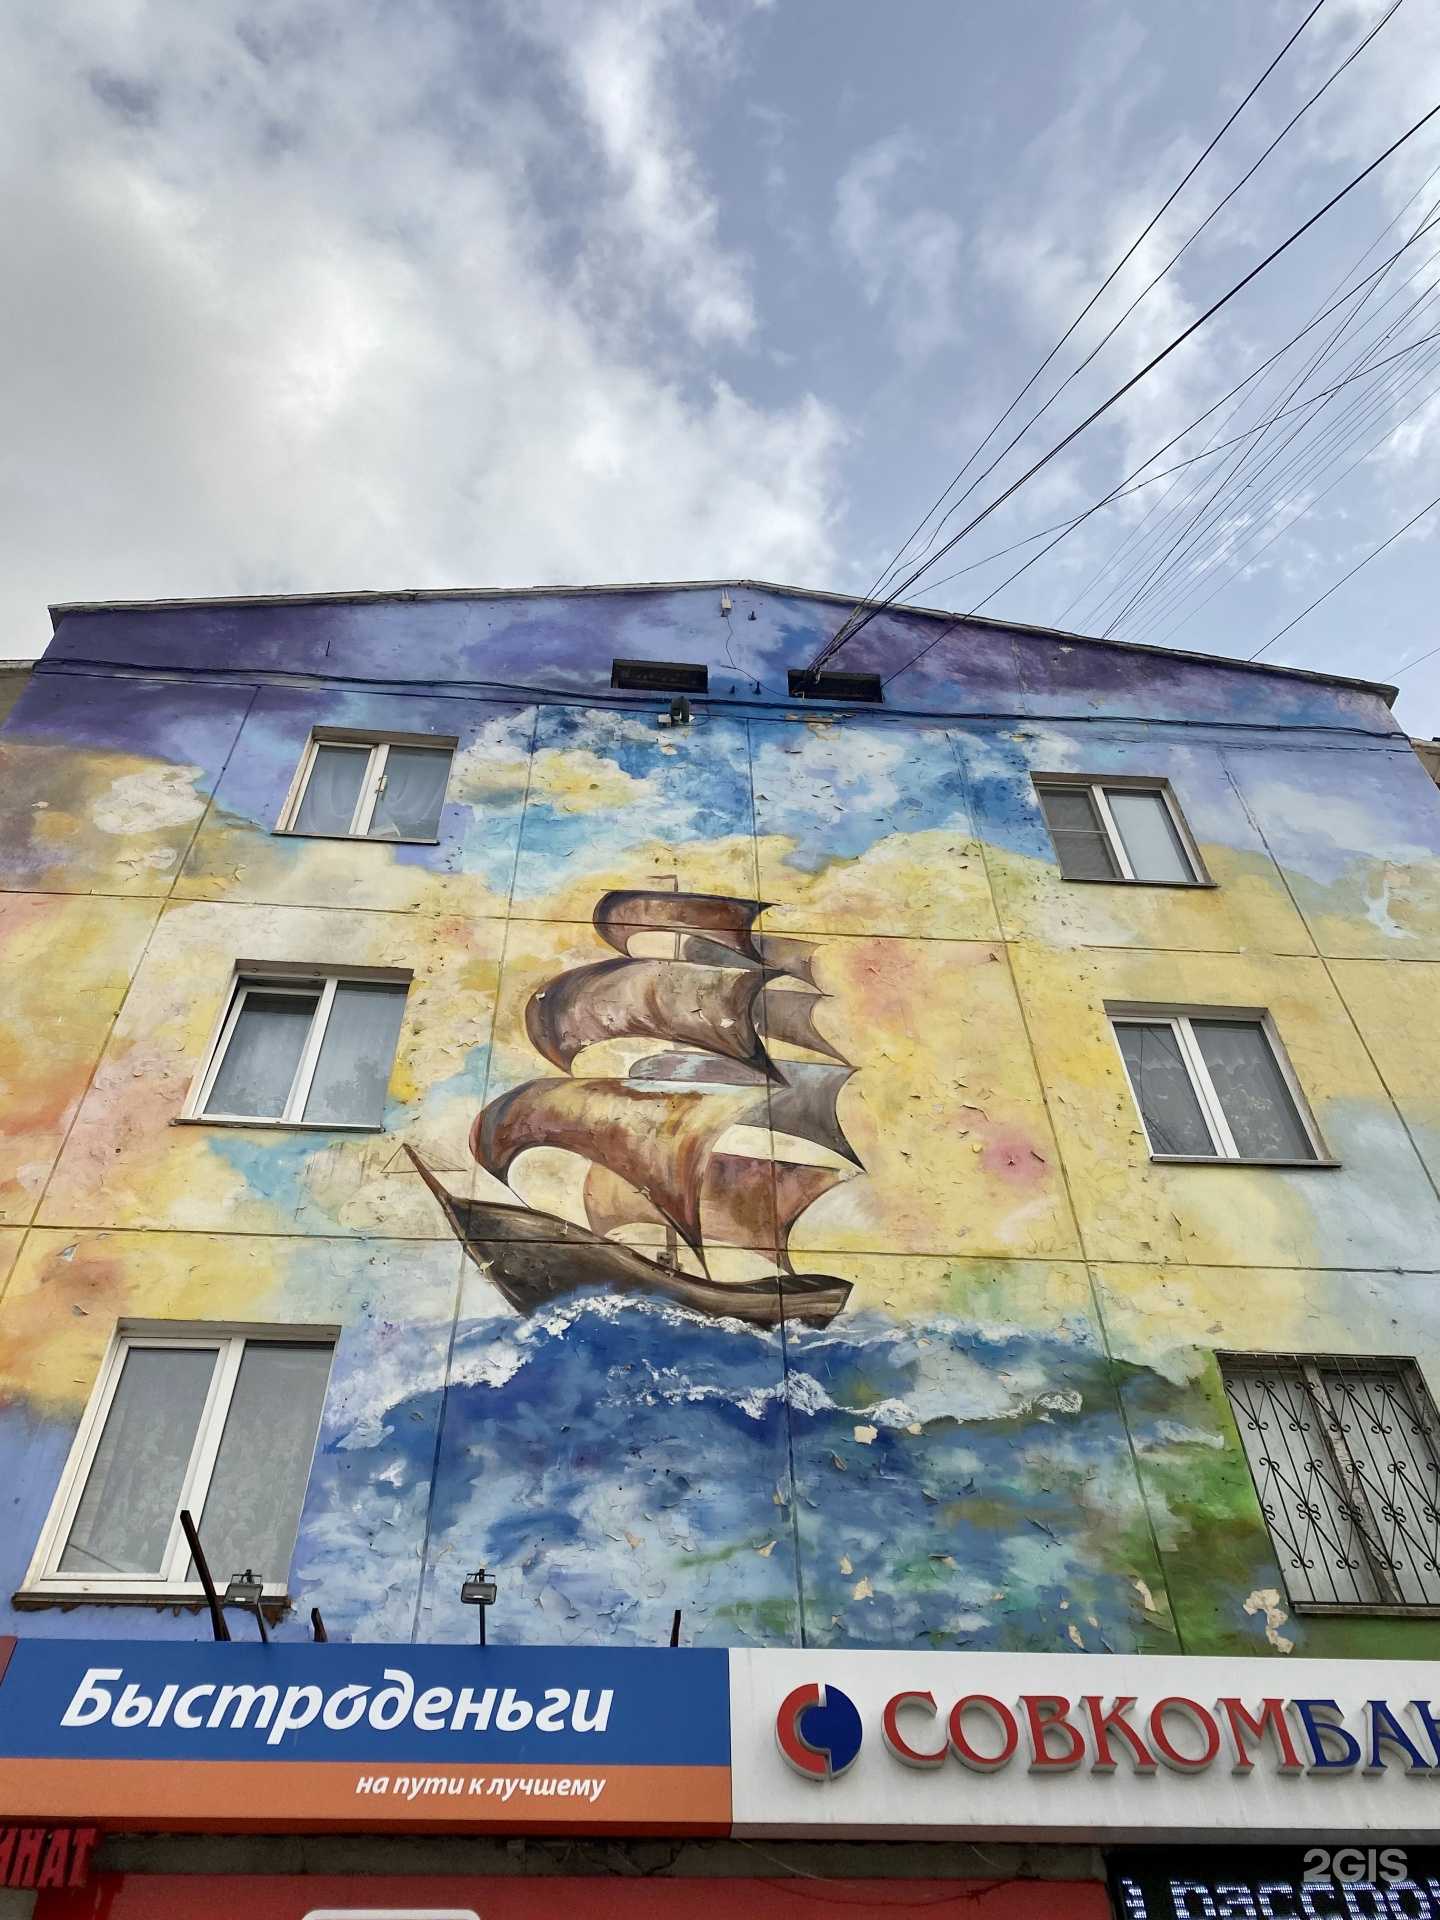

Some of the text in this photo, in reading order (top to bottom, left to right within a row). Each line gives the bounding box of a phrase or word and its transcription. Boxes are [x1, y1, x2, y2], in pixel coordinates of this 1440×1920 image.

[60, 1668, 614, 1745] Быстроденьги
[355, 1776, 607, 1803] на пути к лучшему
